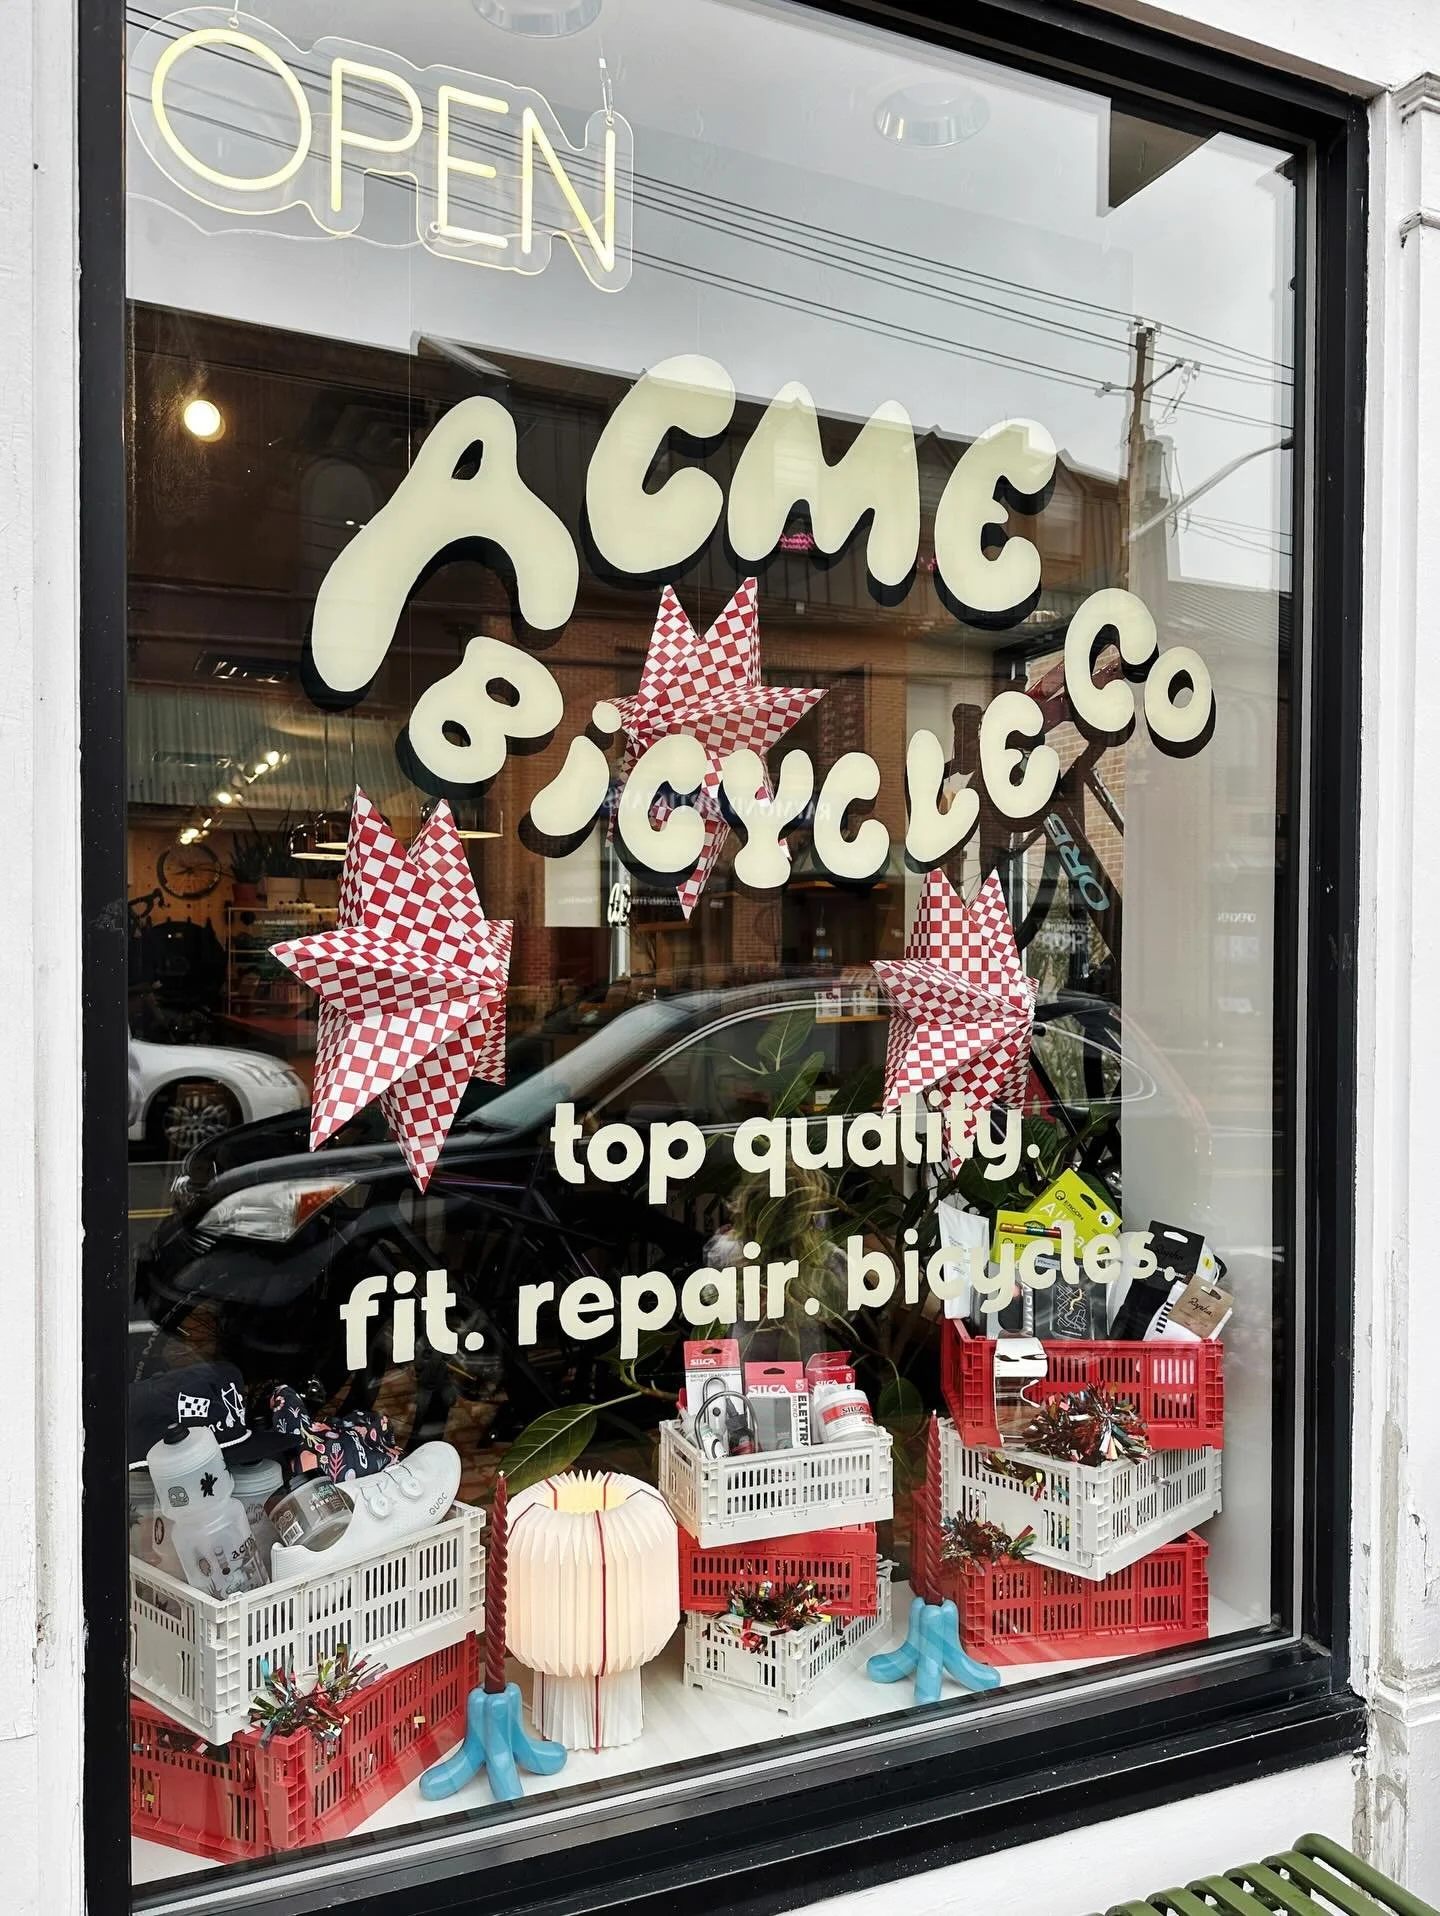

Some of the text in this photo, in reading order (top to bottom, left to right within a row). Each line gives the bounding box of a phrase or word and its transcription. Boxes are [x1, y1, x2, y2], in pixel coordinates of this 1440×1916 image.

[151, 27, 616, 273] OPEN
[310, 354, 1057, 694] ACME
[550, 1090, 1041, 1205] top quality.
[339, 1269, 486, 1371] fit.
[517, 1241, 820, 1360] repair.
[846, 1219, 1177, 1314] bicycles.
[690, 1358, 717, 1366] SILCA
[748, 1384, 790, 1394] SILCA
[841, 1405, 866, 1414] SILCA
[428, 1493, 448, 1516] QUOC
